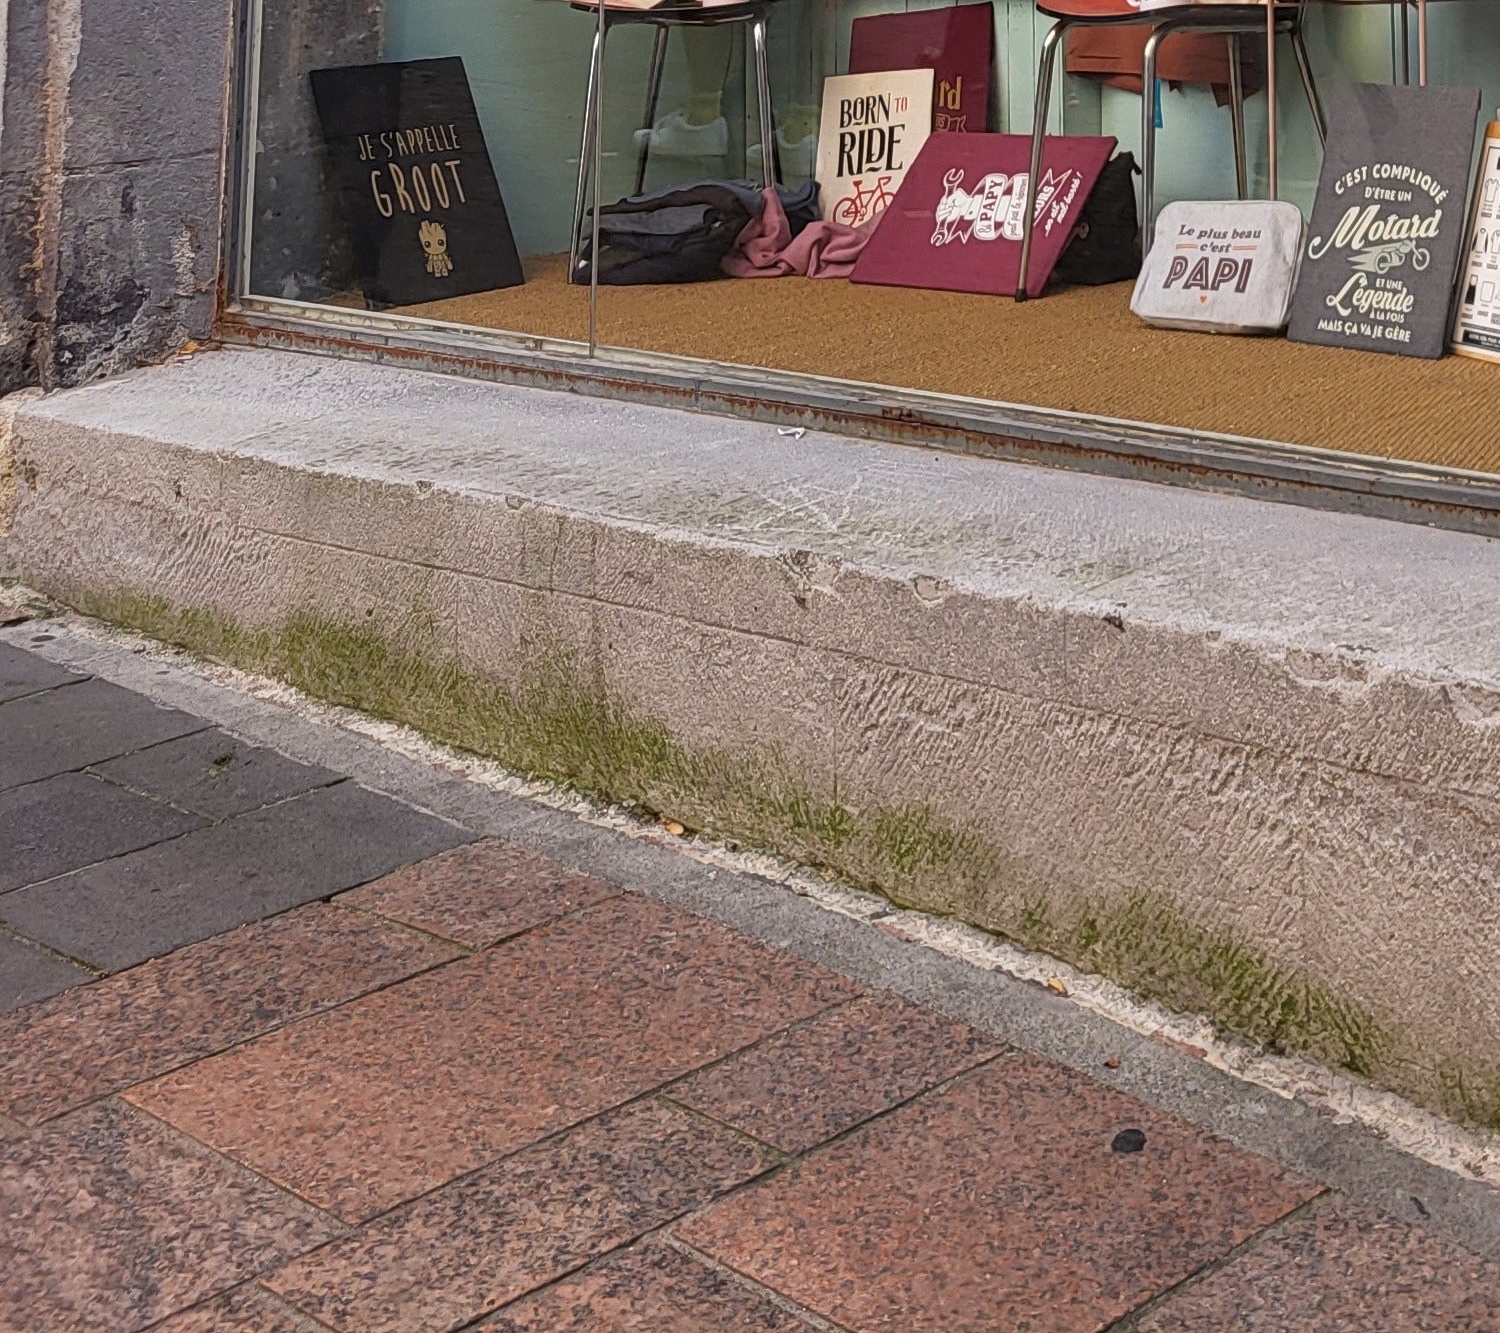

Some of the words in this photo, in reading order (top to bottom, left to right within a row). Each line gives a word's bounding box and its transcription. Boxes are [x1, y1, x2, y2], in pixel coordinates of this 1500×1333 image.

[839, 91, 892, 129] BORN
[893, 95, 908, 114] TO
[357, 133, 376, 161] JE
[380, 124, 460, 159] S'APPELLE
[837, 123, 906, 178] RIDE
[371, 160, 466, 218] GROOT
[979, 179, 1004, 222] PAPY
[1335, 166, 1367, 196] C'EST
[1373, 163, 1449, 205] COMPLIQUÉ
[1364, 186, 1395, 201] D'ÊTRE
[1397, 190, 1412, 202] UN
[1177, 224, 1194, 238] Le
[1196, 227, 1228, 242] plus
[1231, 227, 1262, 240] beau
[1199, 241, 1232, 254] c'est
[1308, 204, 1443, 260] Motard
[1162, 255, 1254, 294] PAPI
[1375, 278, 1386, 289] ET
[1386, 279, 1403, 291] UNE
[1326, 272, 1415, 317] Légende
[1317, 318, 1343, 333] MAIS
[1343, 319, 1358, 338] ÇA
[1358, 323, 1372, 337] VA
[1372, 325, 1383, 340] JE
[1384, 324, 1412, 343] GÈRE
[1377, 309, 1386, 322] LA
[1386, 310, 1405, 324] FOIS
